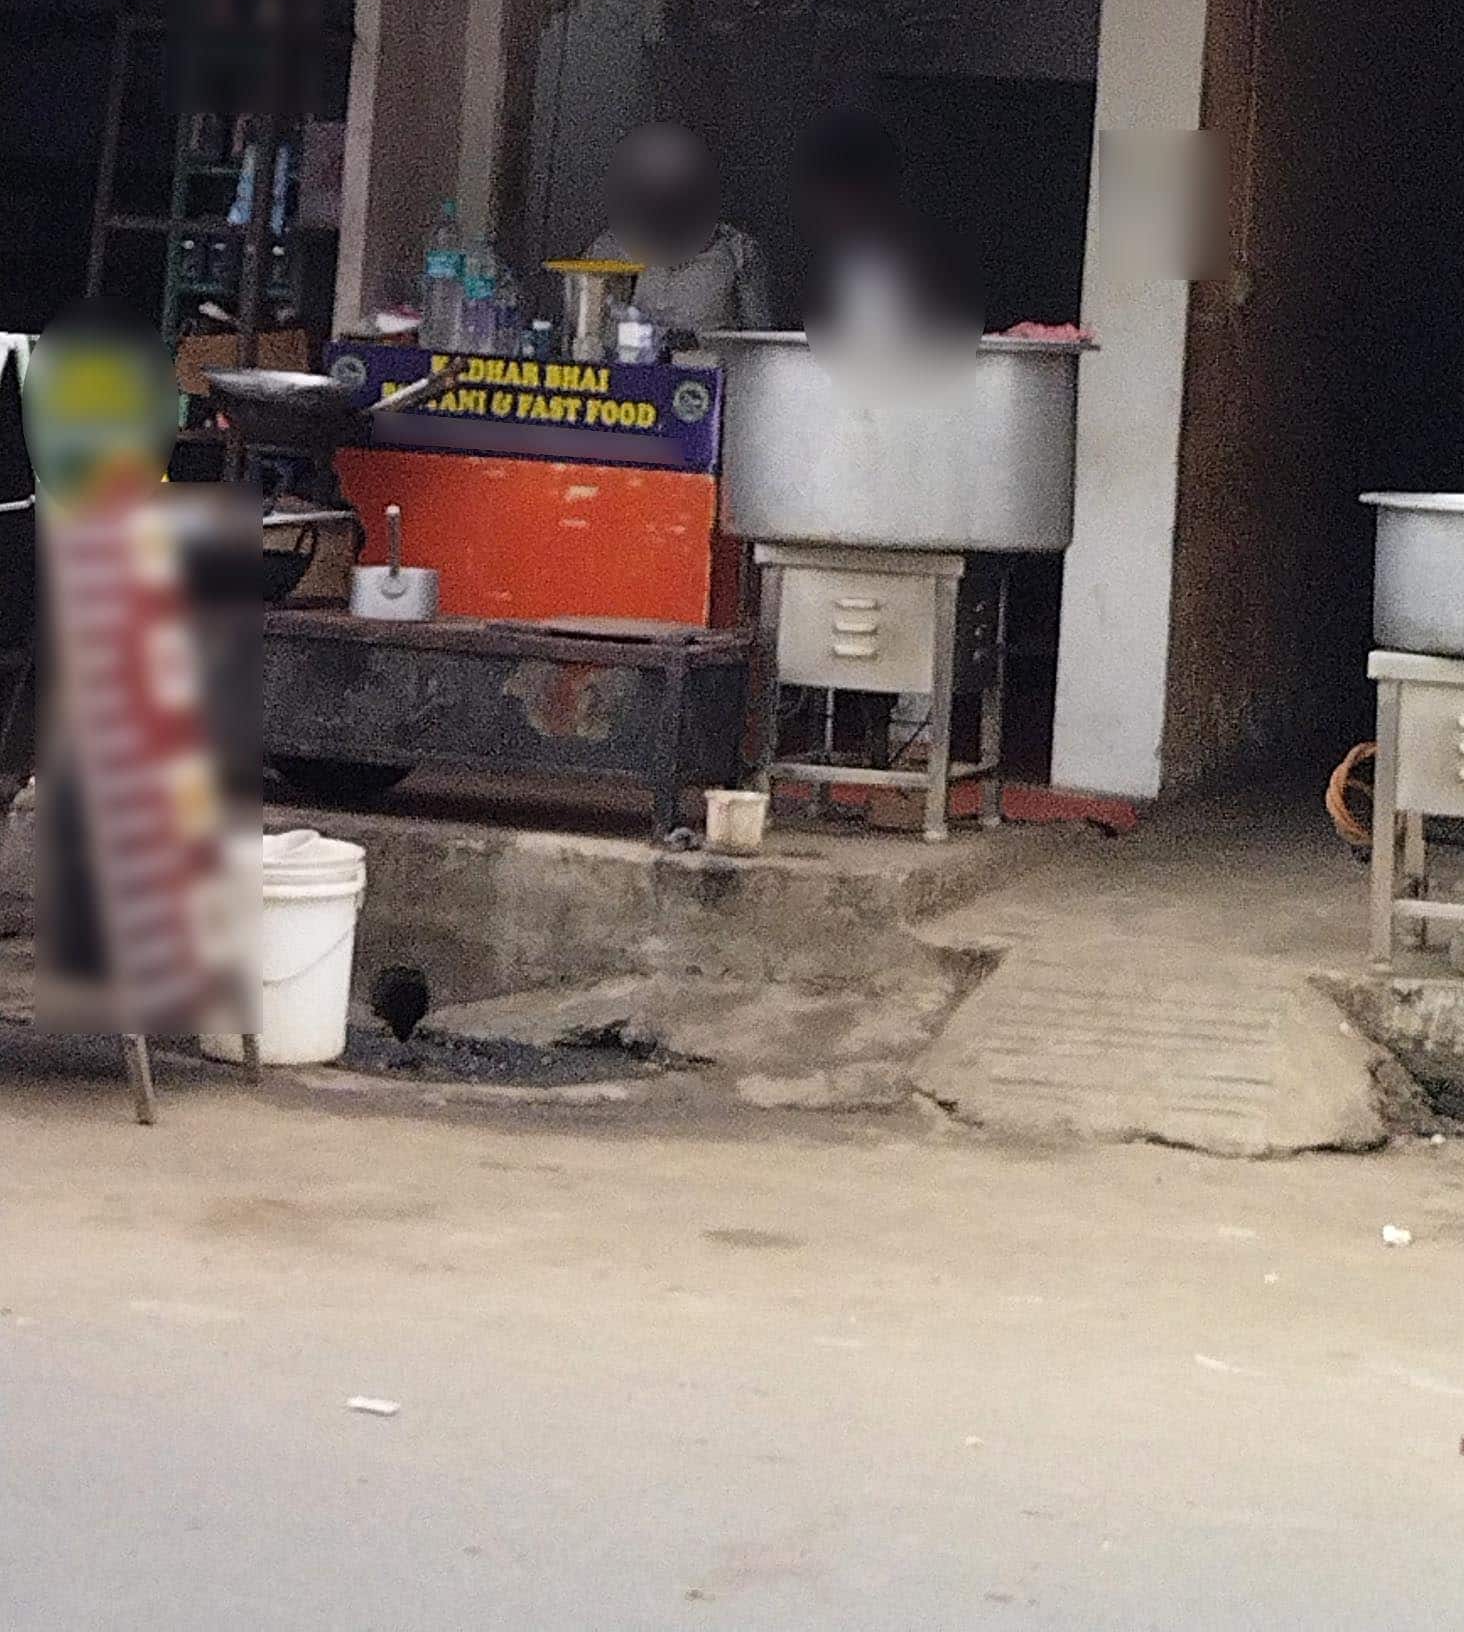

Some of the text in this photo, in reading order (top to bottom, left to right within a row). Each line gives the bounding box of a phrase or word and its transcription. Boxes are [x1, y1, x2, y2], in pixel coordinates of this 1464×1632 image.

[430, 353, 611, 394] KDHAR BHAI
[516, 392, 583, 426] FAST
[585, 398, 658, 429] FOOD
